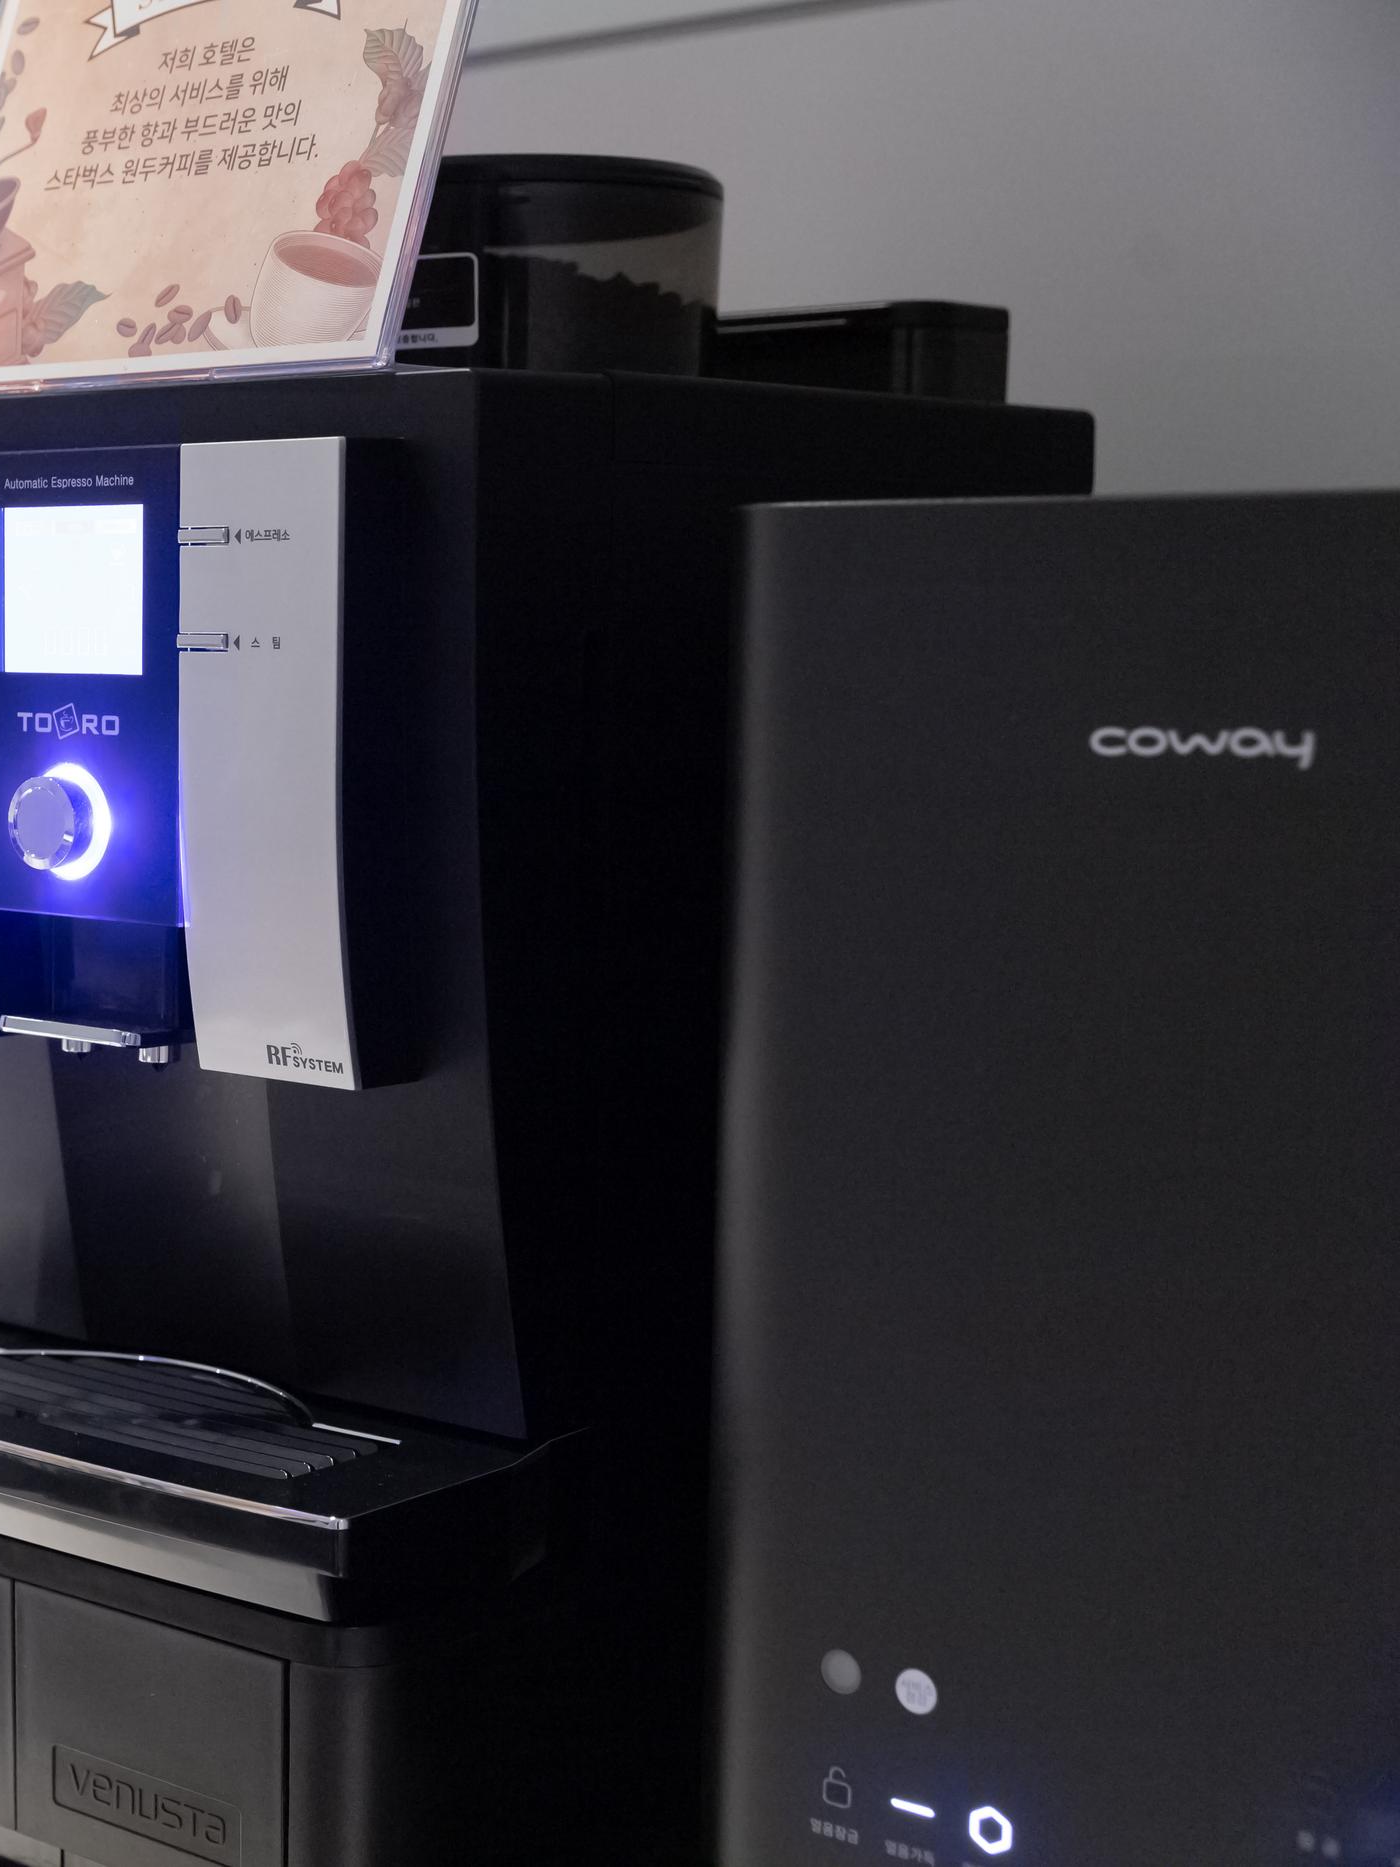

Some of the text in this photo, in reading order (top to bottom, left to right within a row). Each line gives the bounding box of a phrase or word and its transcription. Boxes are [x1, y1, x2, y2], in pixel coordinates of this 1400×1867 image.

[158, 36, 255, 74] 저희 호텔은
[109, 65, 290, 115] 최상의 서비스를 위해
[81, 99, 302, 155] 풍부한 향과 부드러운 맛의
[44, 134, 319, 191] 스타벅스 원두커피를 제공합니다.
[4, 474, 134, 490] Automatic Espresso Machine
[245, 529, 291, 542] 에스프레소
[1089, 726, 1316, 771] coway
[293, 1055, 344, 1075] SYSTEM
